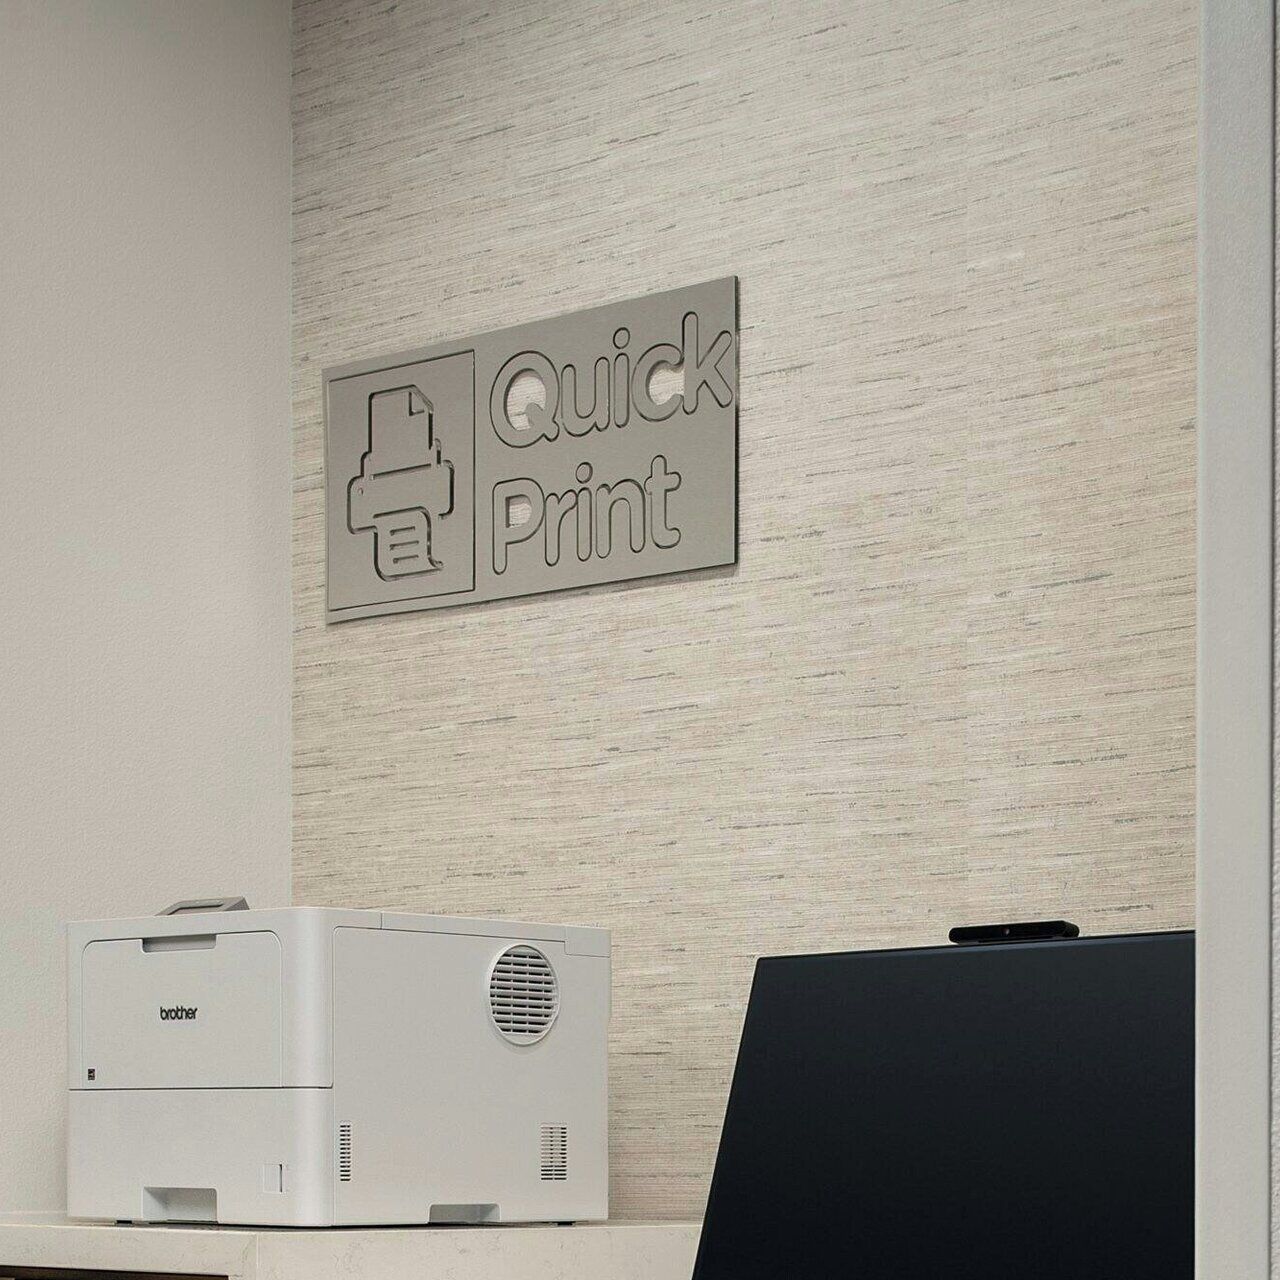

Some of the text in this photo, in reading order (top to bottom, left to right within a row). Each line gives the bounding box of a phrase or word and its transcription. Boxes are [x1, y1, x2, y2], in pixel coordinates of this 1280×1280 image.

[489, 311, 734, 448] Quick
[491, 455, 682, 575] Print
[160, 1006, 198, 1020] brother
